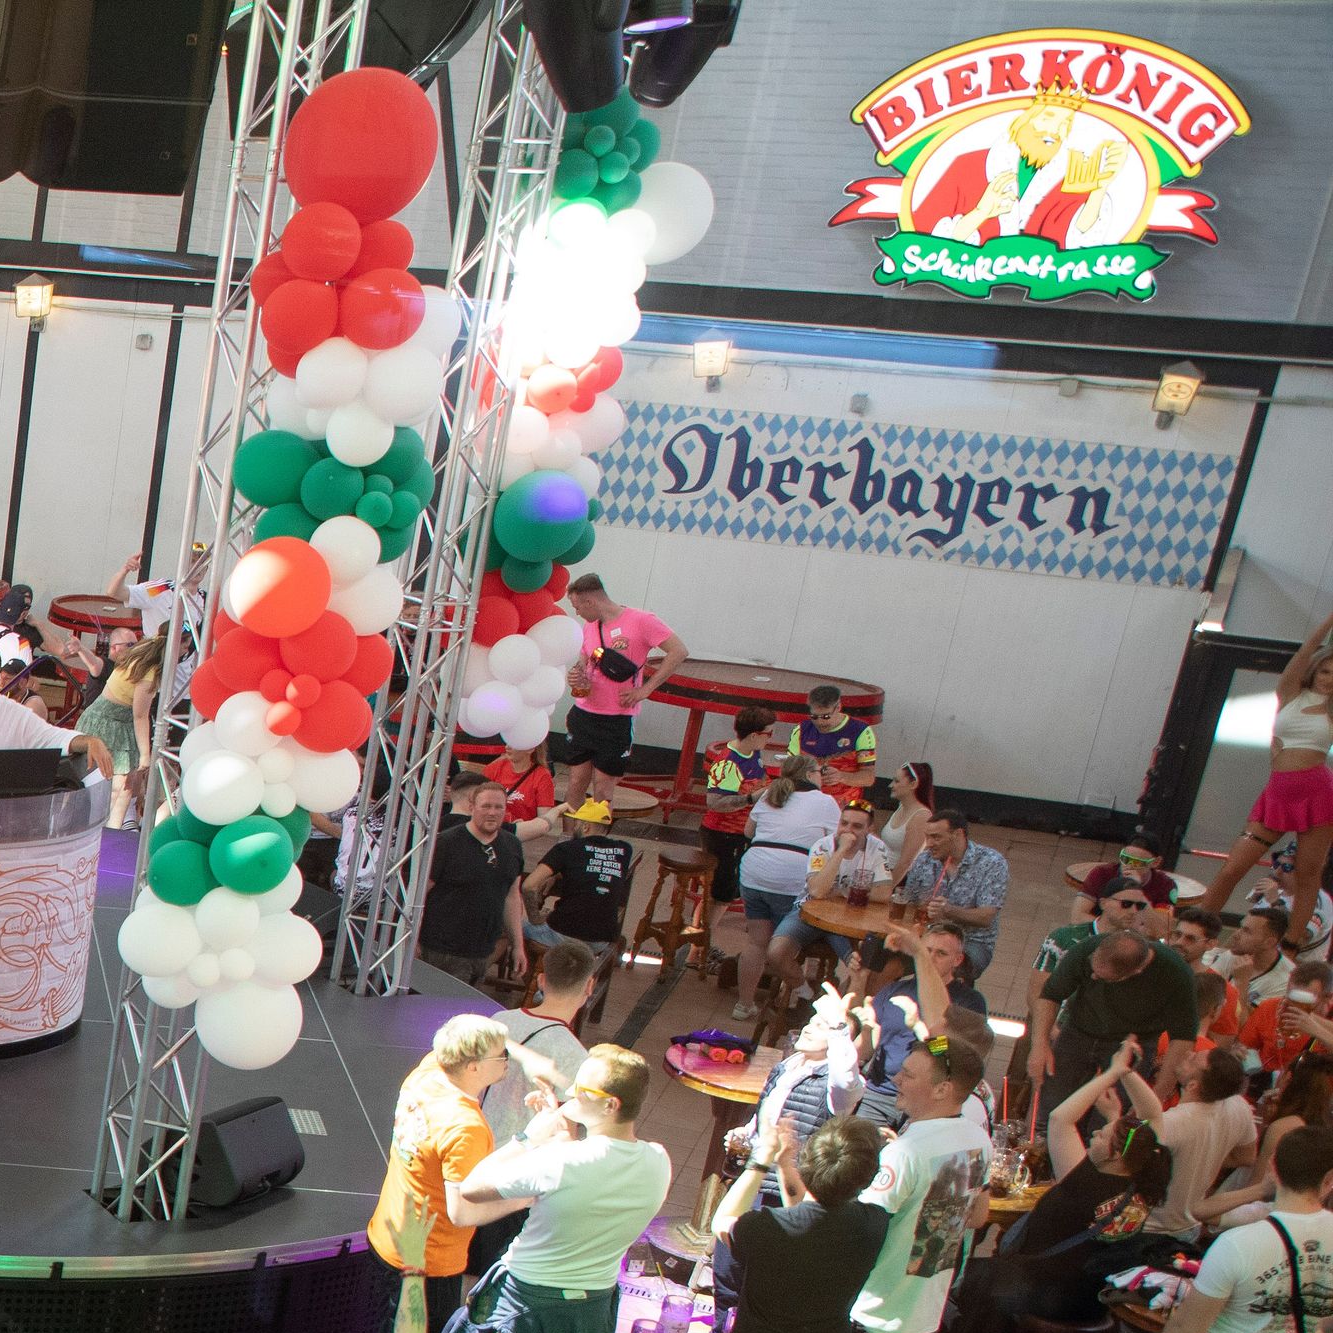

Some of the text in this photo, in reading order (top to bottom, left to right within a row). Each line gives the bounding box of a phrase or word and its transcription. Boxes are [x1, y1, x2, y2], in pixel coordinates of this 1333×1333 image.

[878, 44, 1230, 149] BIERKÖNIG
[902, 244, 1137, 284] Schinkenstrasse
[660, 422, 1122, 549] Oberbayern
